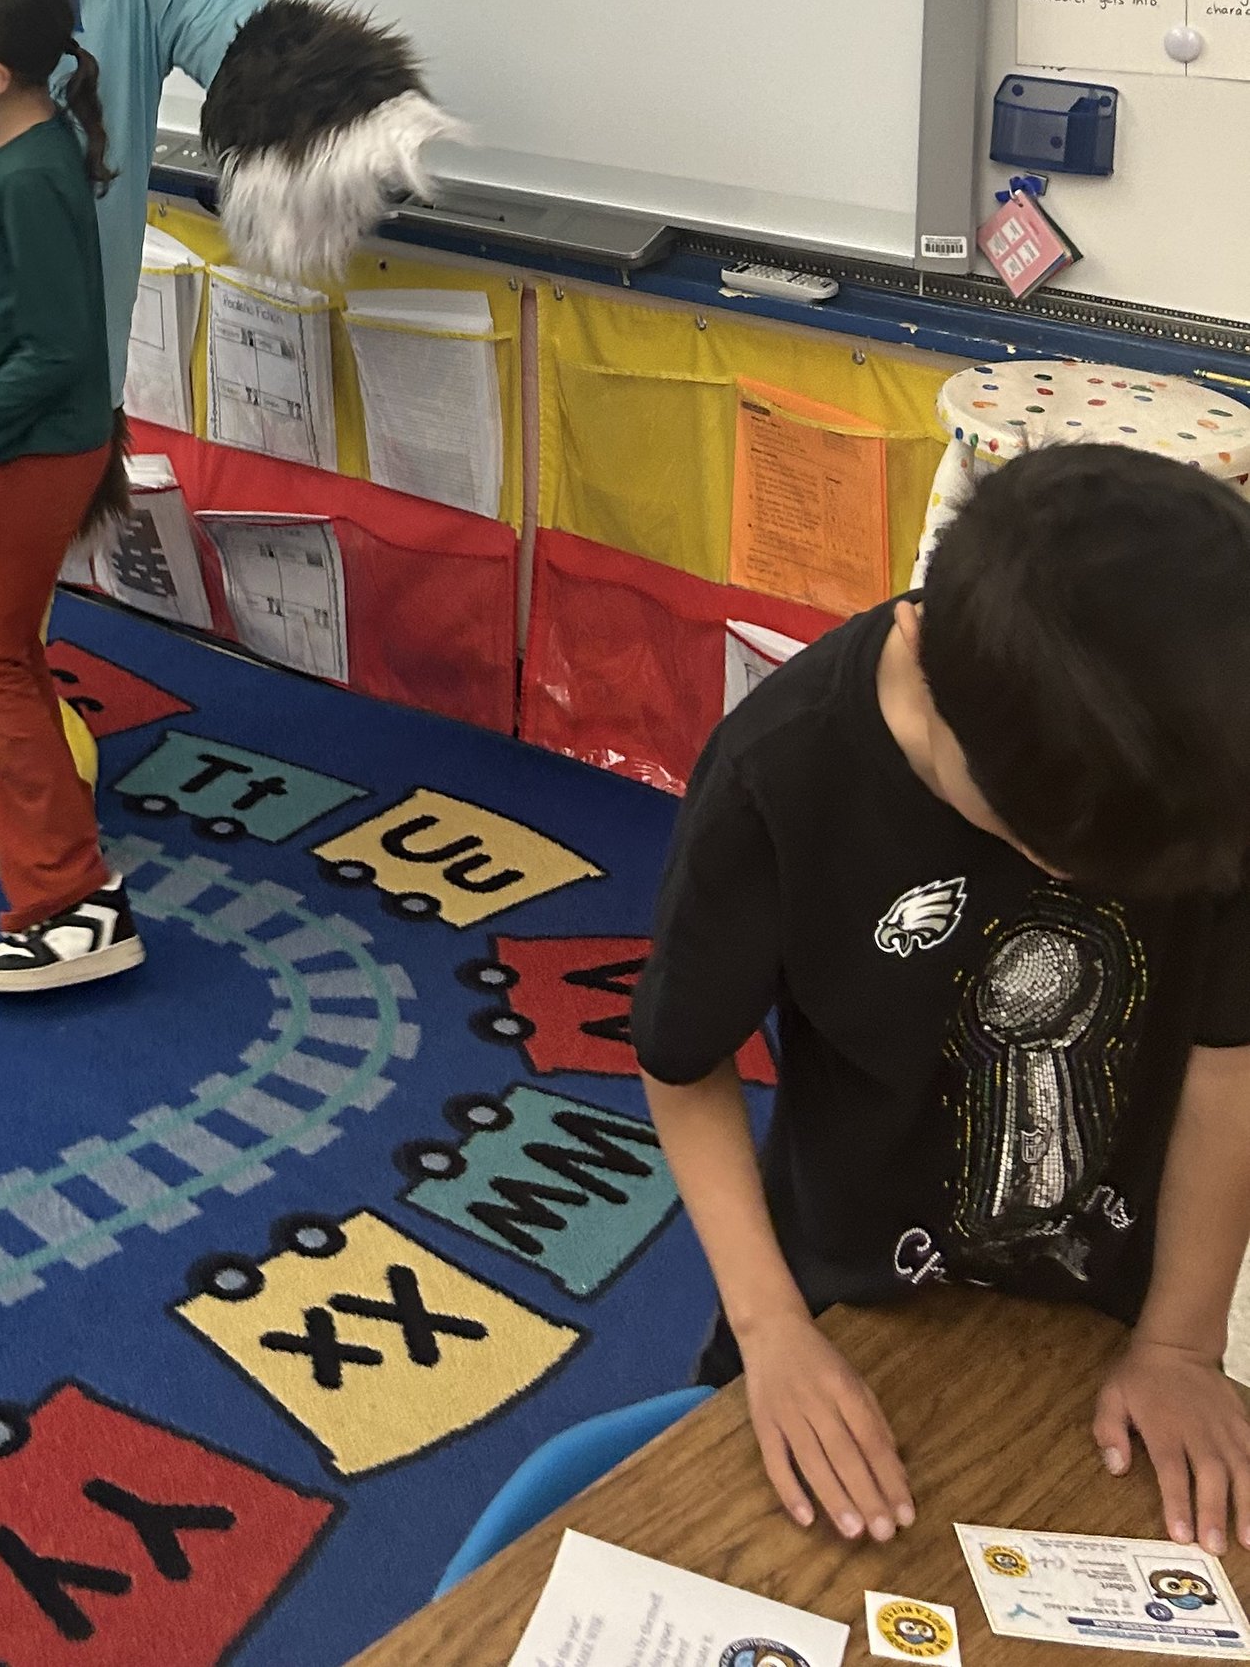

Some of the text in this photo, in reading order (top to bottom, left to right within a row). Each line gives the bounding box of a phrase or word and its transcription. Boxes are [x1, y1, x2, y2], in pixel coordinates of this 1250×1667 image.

[179, 753, 289, 811] Tt
[381, 814, 525, 893] Uu
[260, 1264, 489, 1390] Xx
